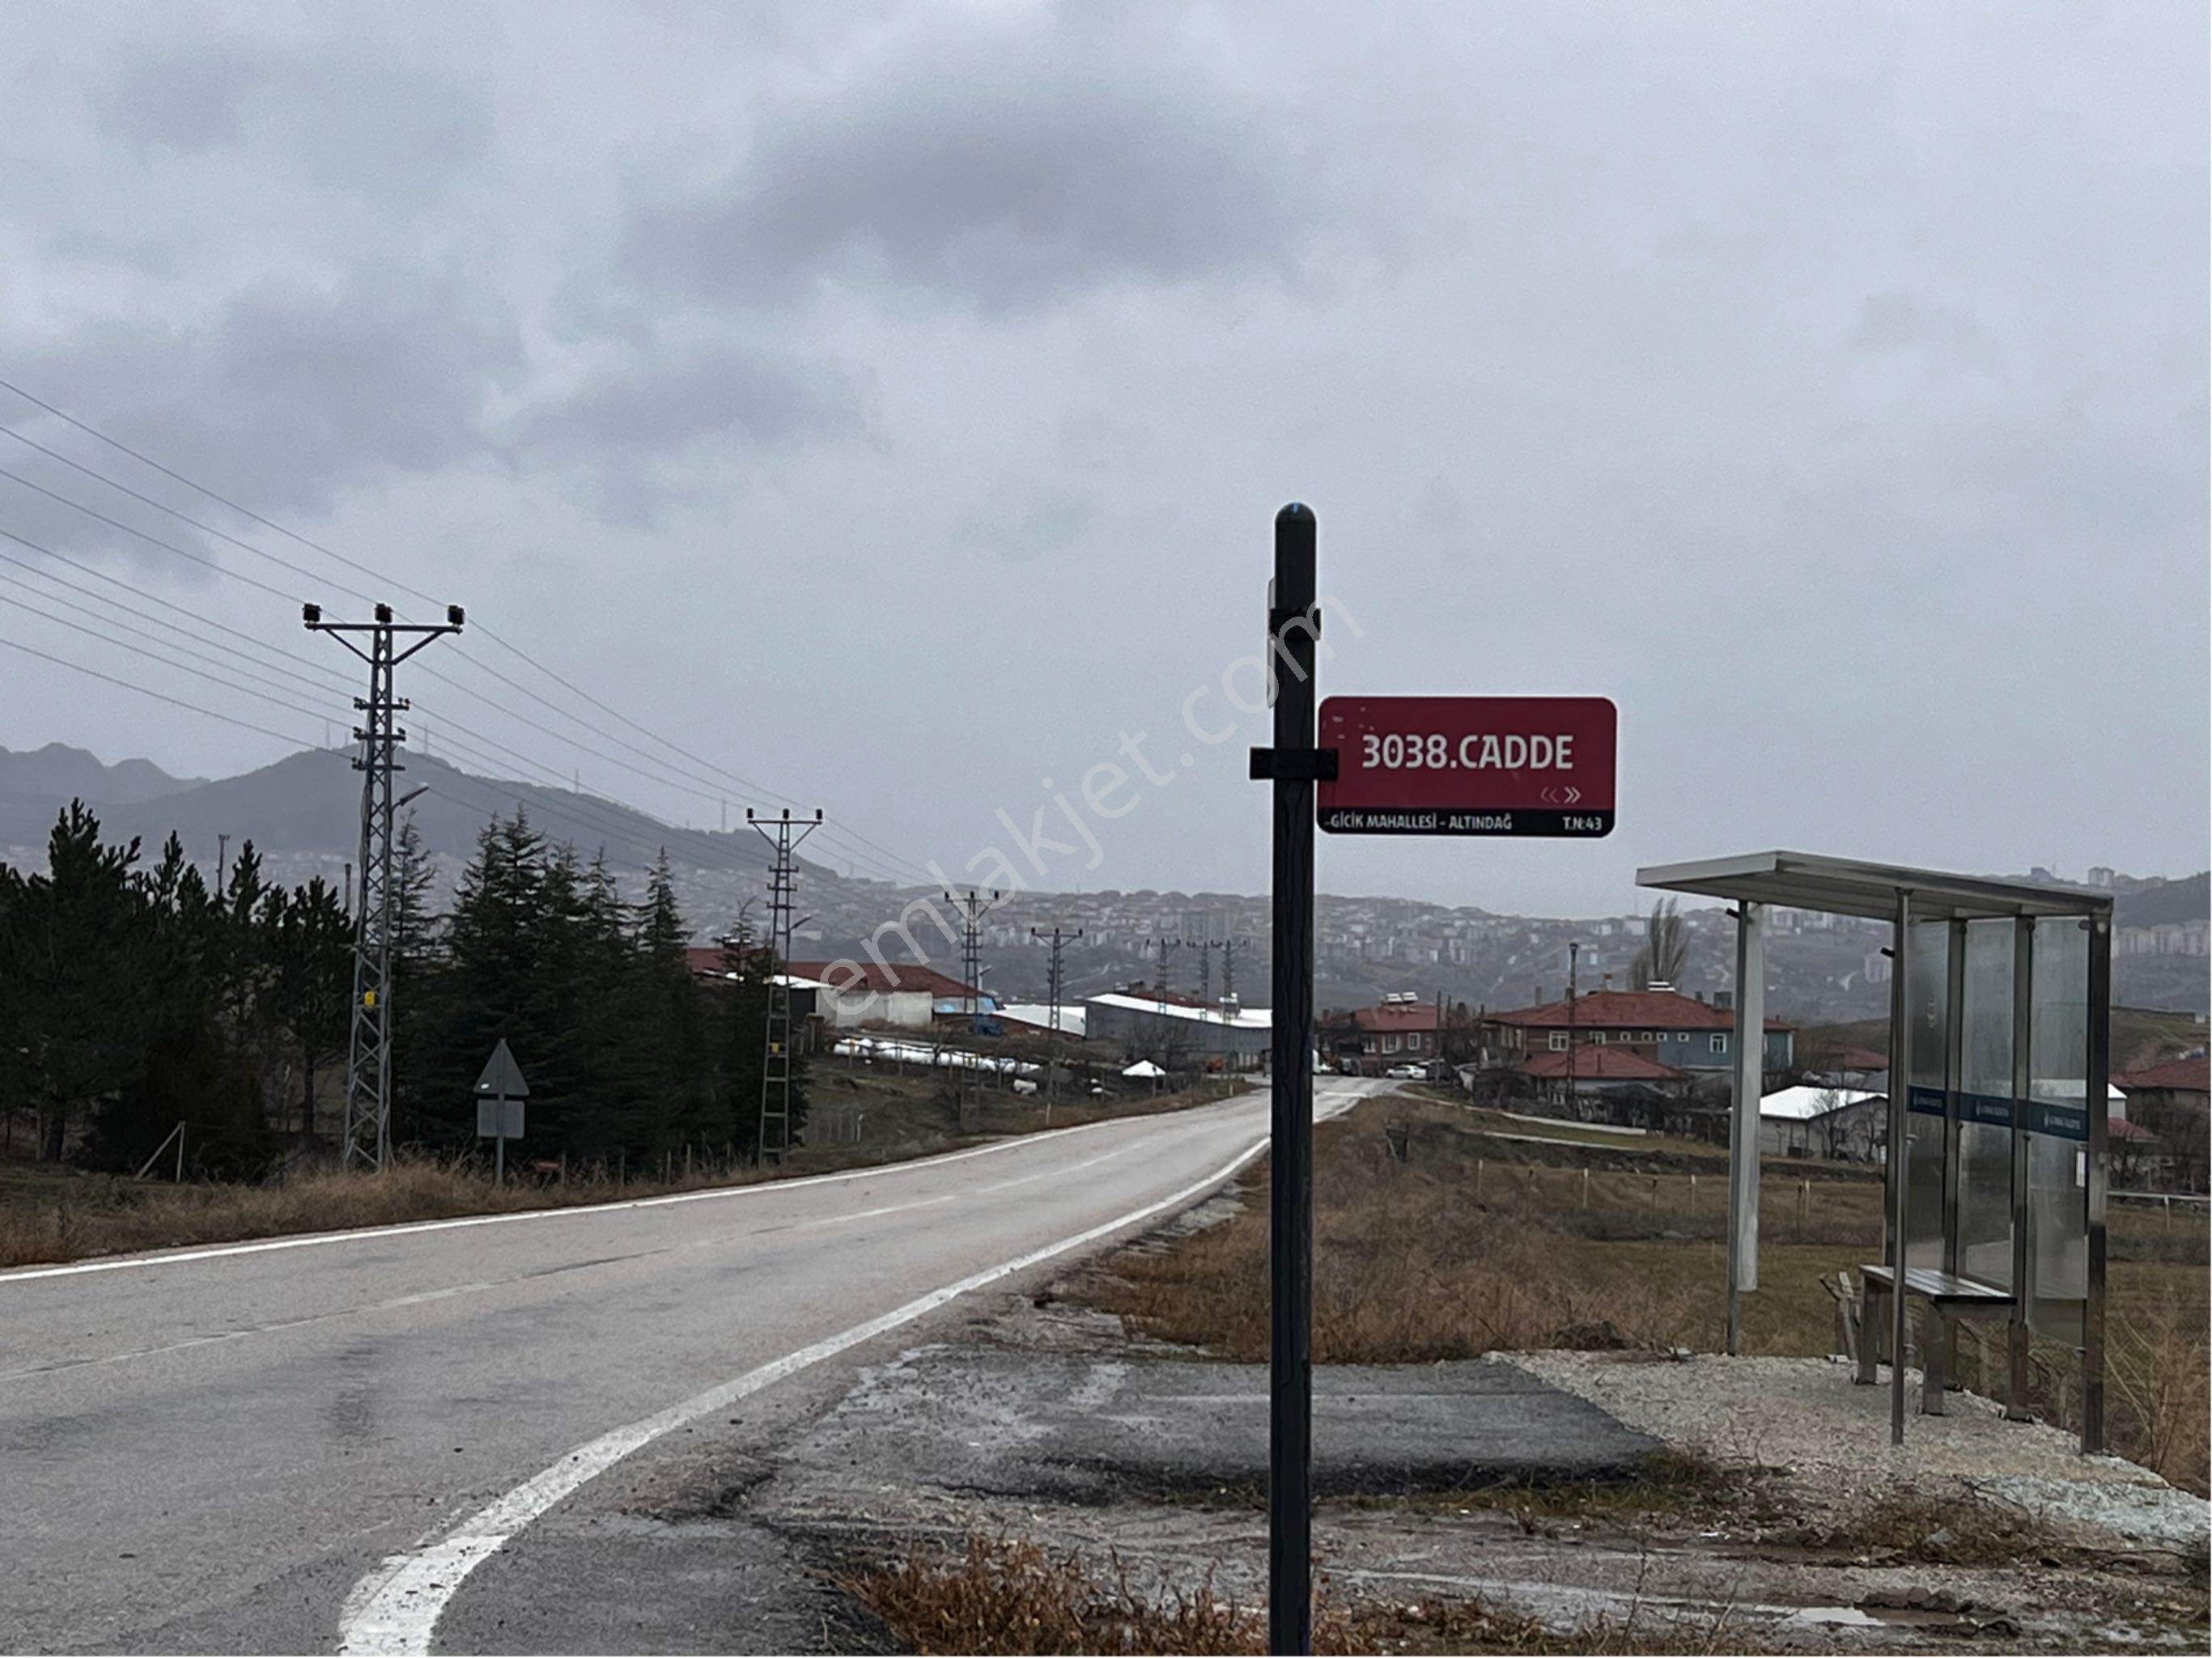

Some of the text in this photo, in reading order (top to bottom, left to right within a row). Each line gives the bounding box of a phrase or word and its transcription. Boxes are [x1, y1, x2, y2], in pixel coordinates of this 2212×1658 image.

[1361, 734, 1574, 770] 3038.CADDE
[1331, 812, 1364, 829] GİCİK
[1366, 813, 1437, 829] MAHALLESİ
[1449, 813, 1512, 830] ALTINDAĞ
